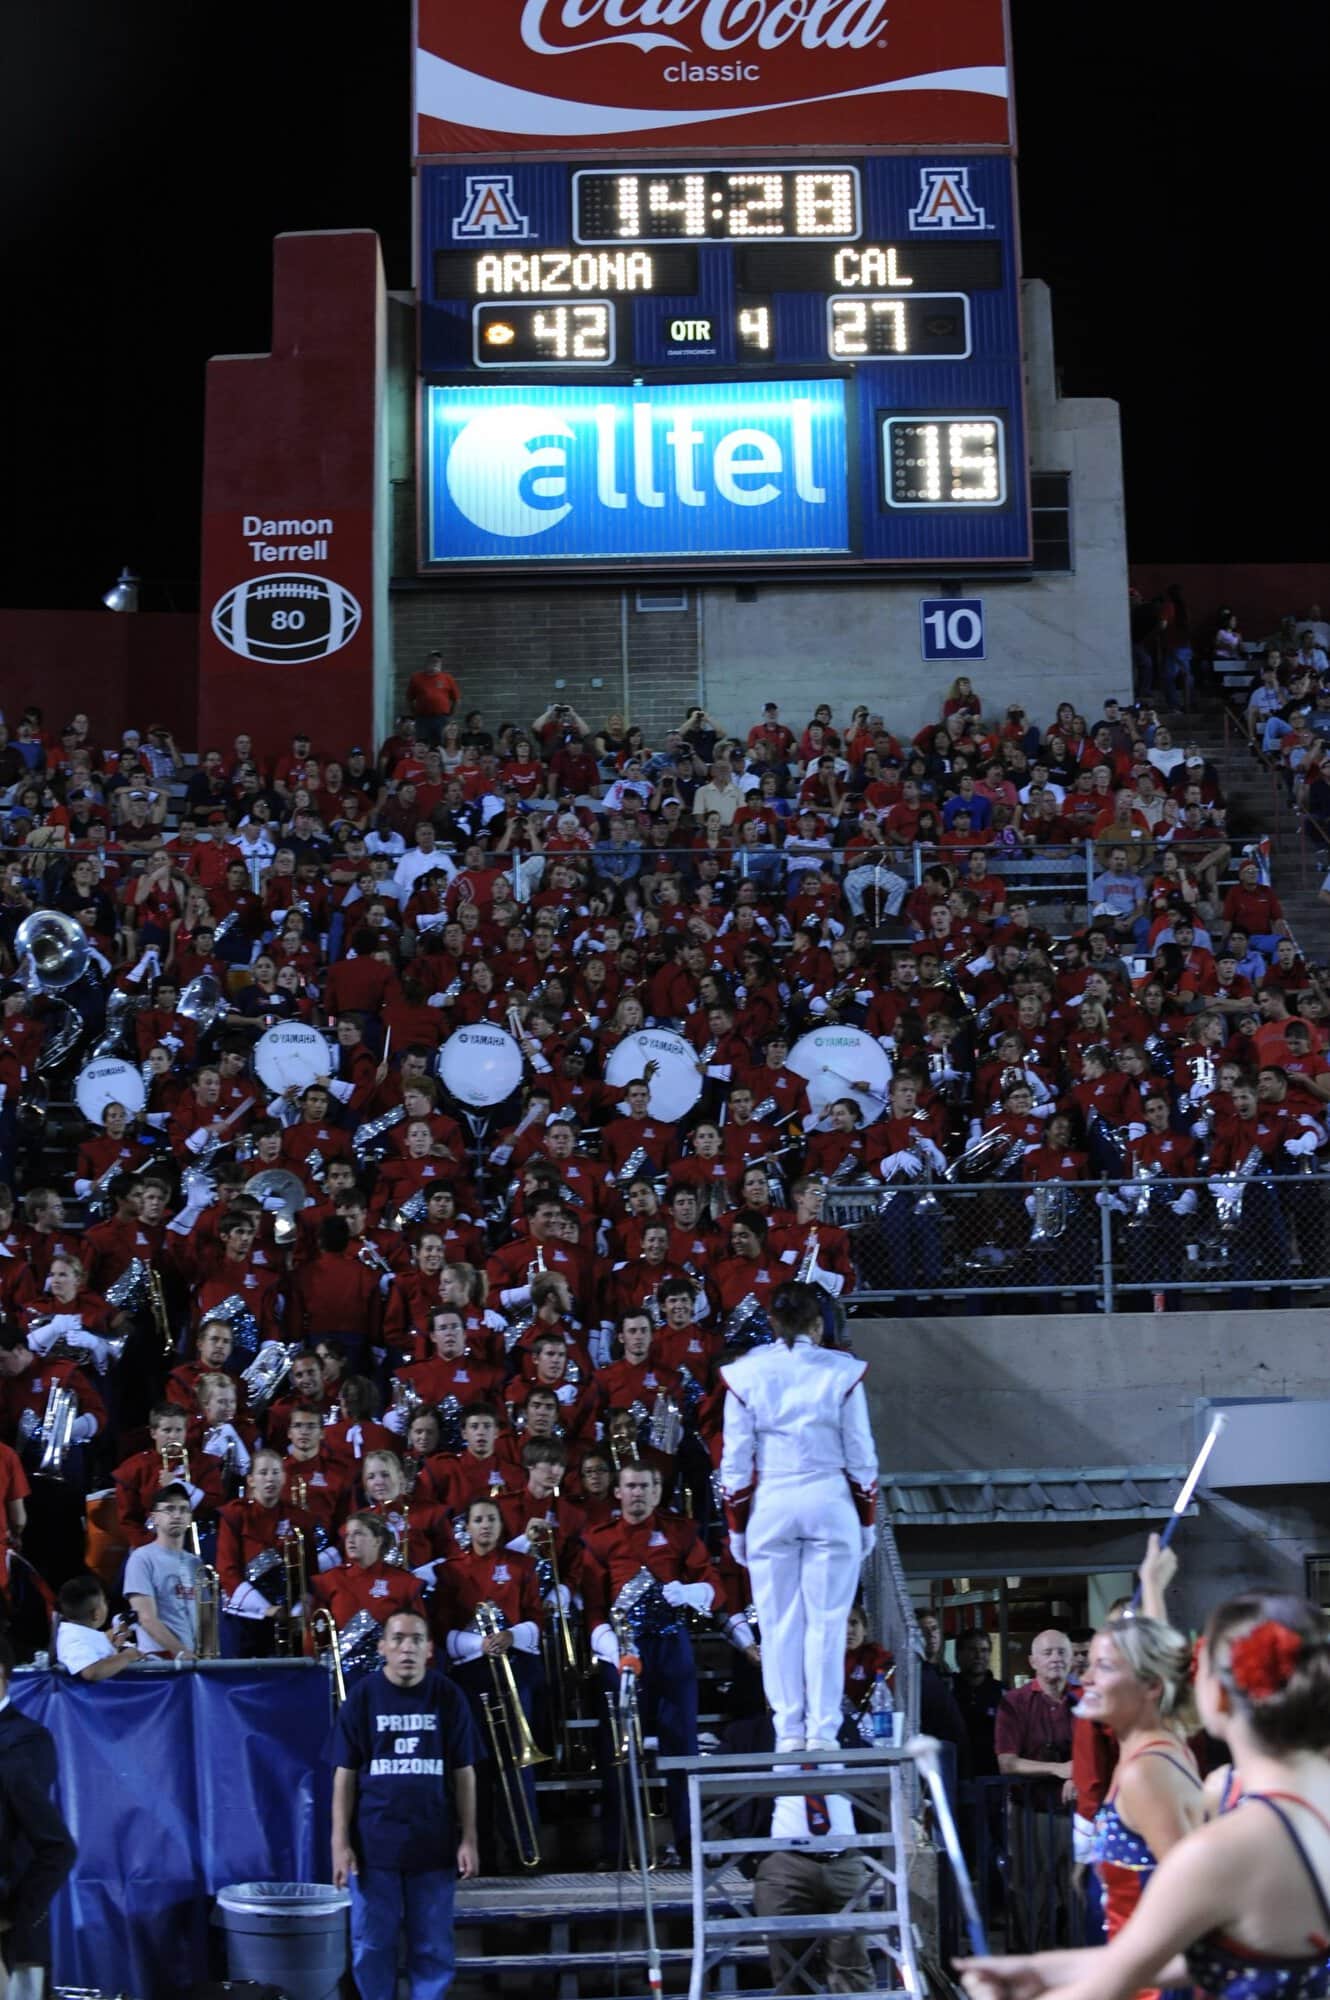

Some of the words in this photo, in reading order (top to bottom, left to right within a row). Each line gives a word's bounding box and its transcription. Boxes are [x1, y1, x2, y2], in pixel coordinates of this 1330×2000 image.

[663, 61, 760, 82] classic
[618, 175, 851, 237] 14:28
[477, 252, 652, 293] ARIZONA
[834, 248, 913, 286] CAL
[533, 306, 606, 357] 42
[671, 320, 711, 341] QTR
[739, 307, 769, 349] 4
[833, 302, 907, 352] 27
[519, 398, 827, 512] alltel
[925, 424, 998, 499] 15
[243, 516, 333, 536] Damon
[248, 540, 328, 562] Terrell
[271, 610, 305, 630] 80
[925, 609, 982, 650] 10
[280, 1033, 317, 1044] YAMAHA
[470, 1034, 505, 1047] YAMAHA
[648, 1039, 685, 1055] YAMAHA
[825, 1038, 861, 1048] YAMAHA
[96, 1065, 127, 1077] YAMAHA
[376, 1714, 437, 1732] PRIDE
[394, 1737, 420, 1754] OF
[370, 1758, 444, 1775] ARIZONA
